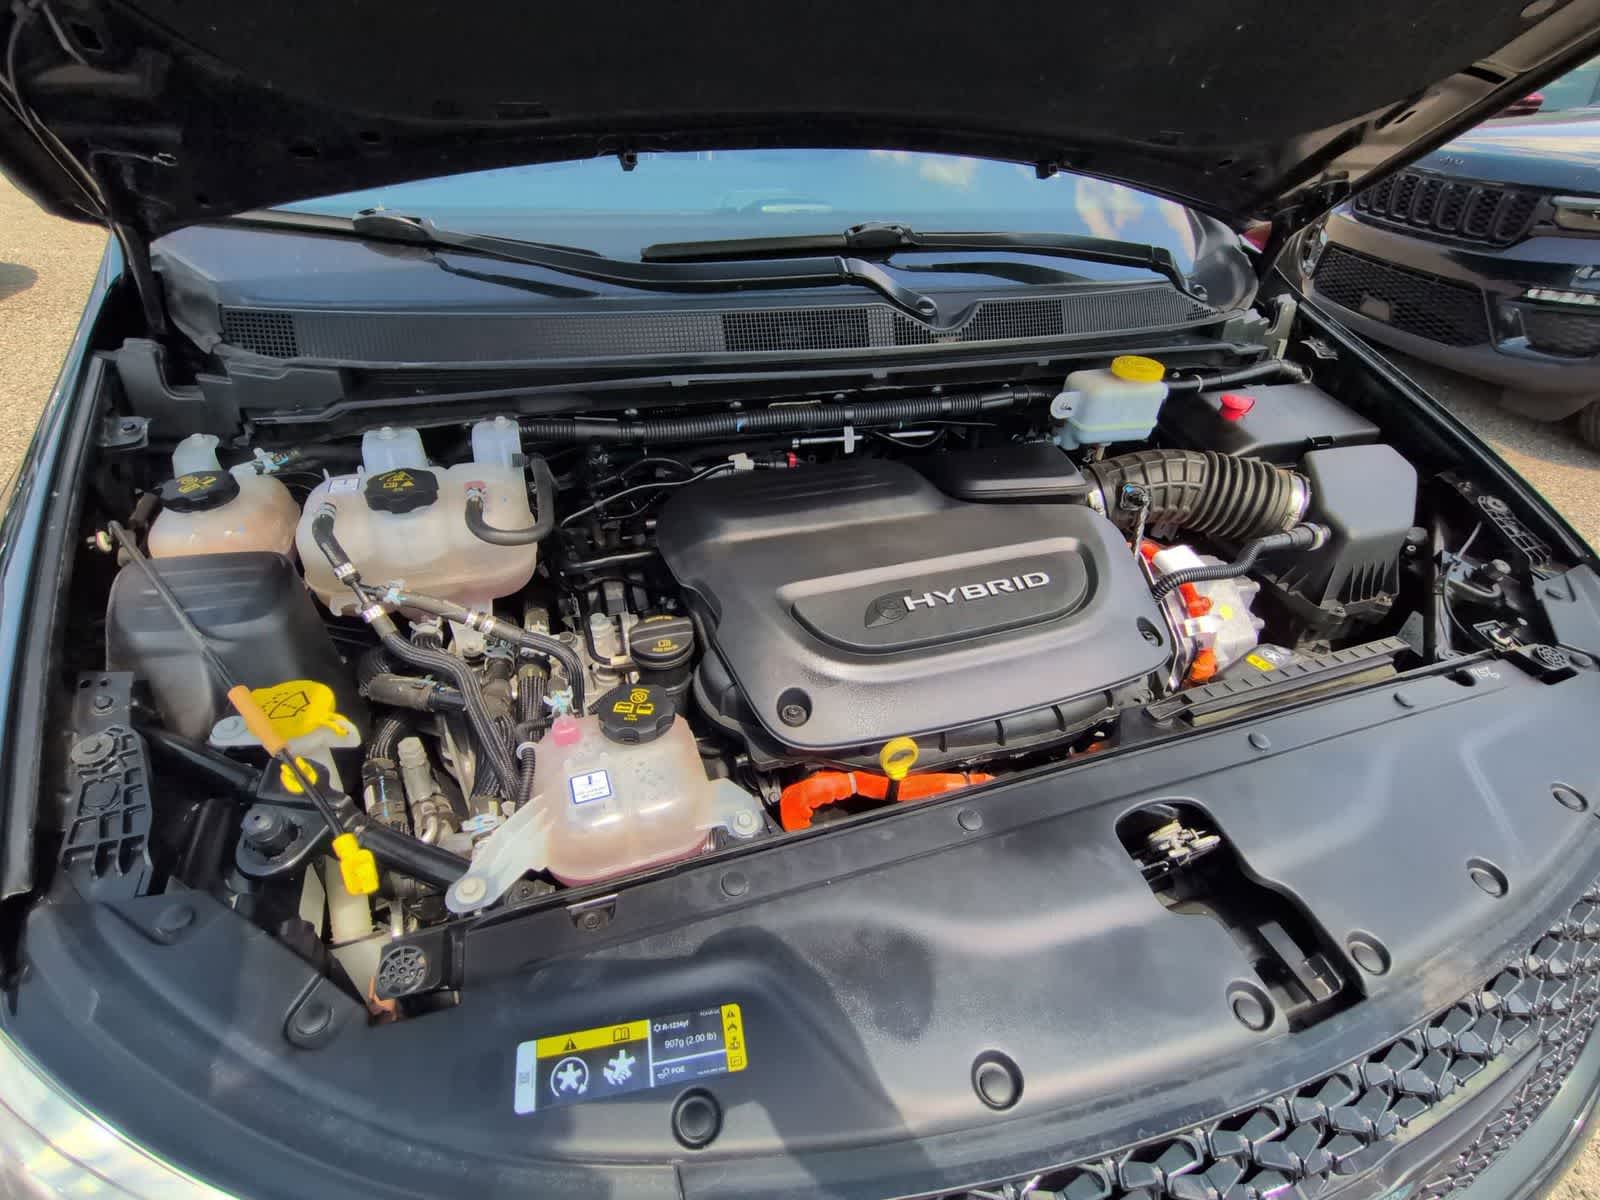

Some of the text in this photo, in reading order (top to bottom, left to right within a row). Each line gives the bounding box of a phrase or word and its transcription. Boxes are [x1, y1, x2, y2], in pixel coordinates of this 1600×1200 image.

[903, 571, 1050, 612] HYBRID
[664, 1031, 717, 1049] 907g (2.00 lb)
